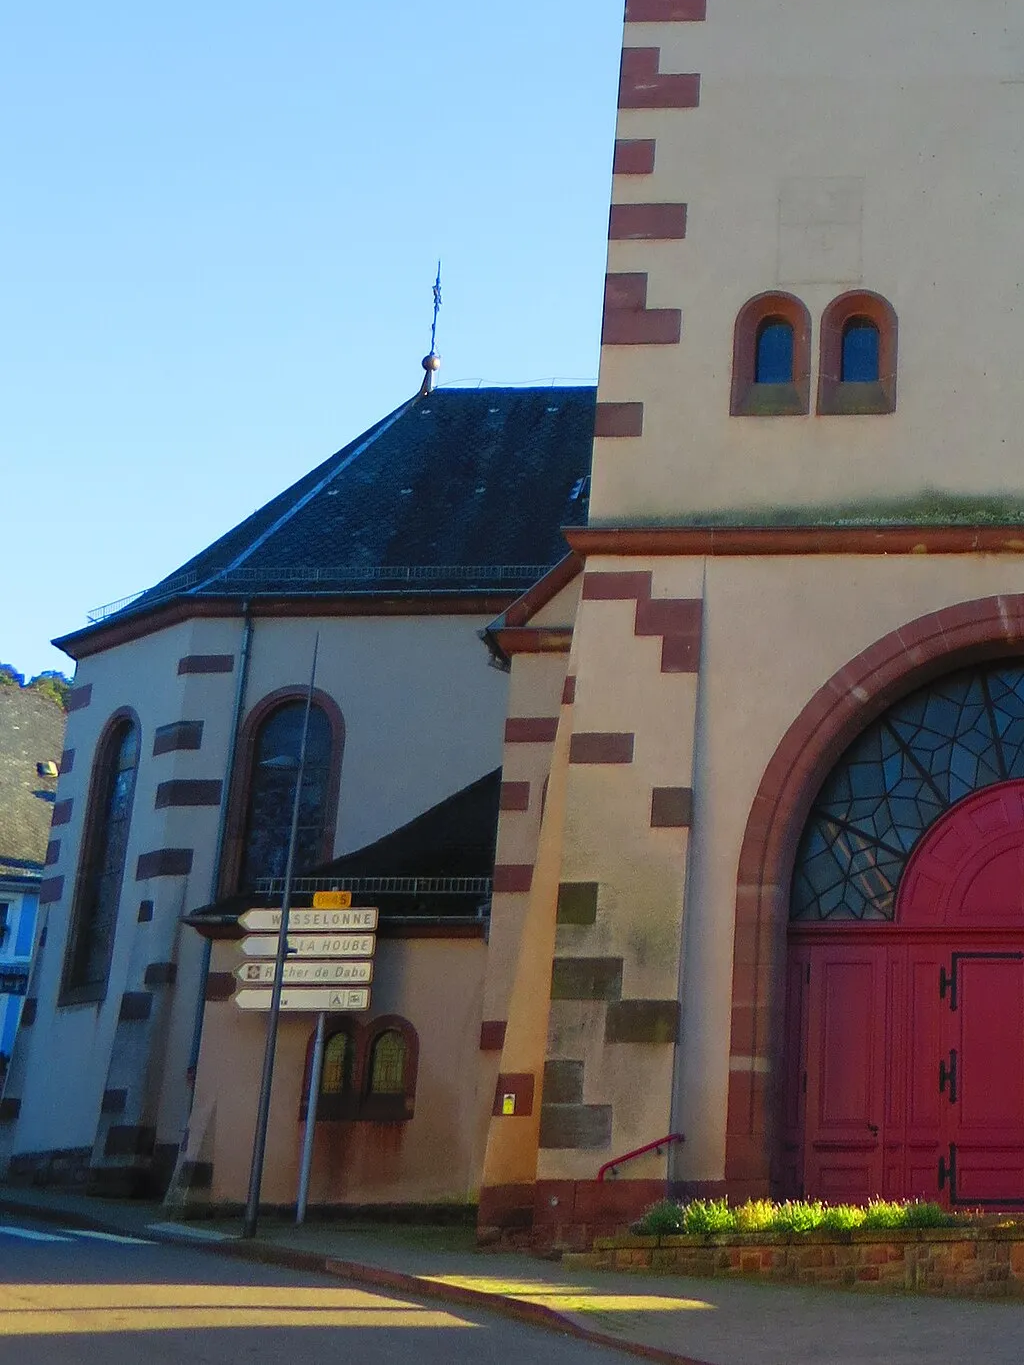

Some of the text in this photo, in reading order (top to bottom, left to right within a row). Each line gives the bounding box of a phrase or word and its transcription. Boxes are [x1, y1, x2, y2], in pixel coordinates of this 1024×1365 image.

[271, 913, 373, 925] WSSELONNE
[299, 939, 369, 951] LA HOUBE
[315, 965, 329, 978] de
[335, 965, 367, 977] Dabo
